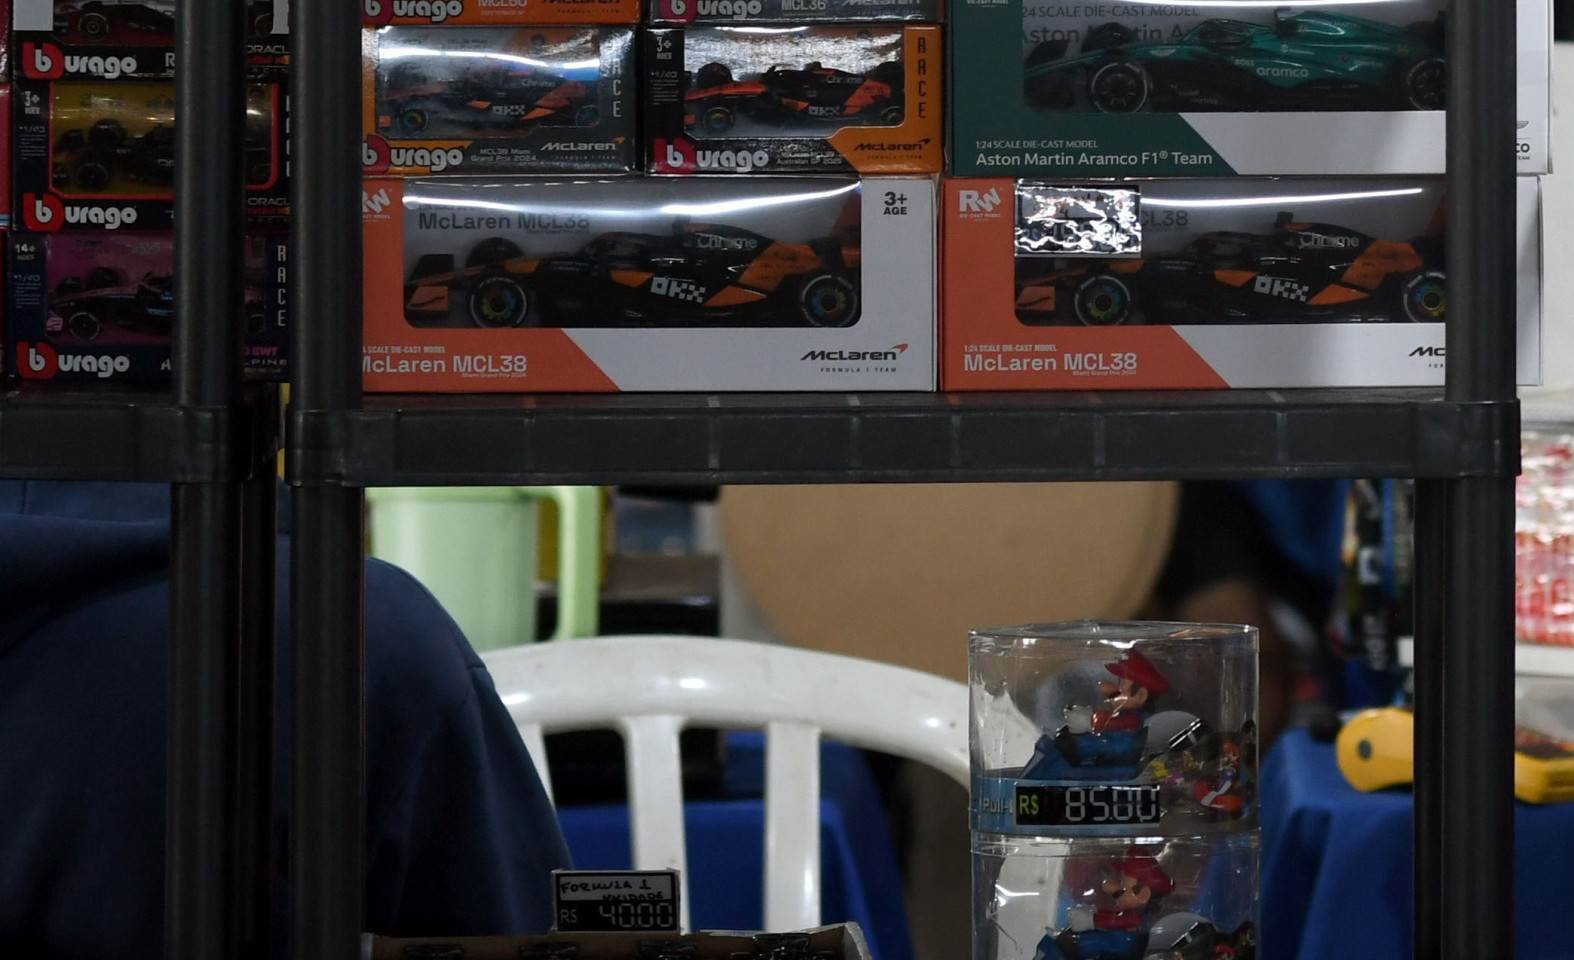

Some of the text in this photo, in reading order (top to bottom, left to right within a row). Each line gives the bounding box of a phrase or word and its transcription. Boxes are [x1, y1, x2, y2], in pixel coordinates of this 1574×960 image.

[781, 0, 826, 10] MCL36
[1039, 6, 1081, 18] SCALE
[1084, 6, 1148, 18] DIE-CAST
[1150, 4, 1199, 17] MODEL
[1256, 66, 1309, 78] aramco
[540, 142, 616, 151] McLaren
[854, 143, 923, 151] McLaren
[993, 140, 1022, 149] SCALE
[1023, 140, 1064, 149] DIE-CAST
[1066, 140, 1099, 148] MODEL
[976, 153, 1021, 166] Aston
[1025, 153, 1074, 165] Martin
[1078, 153, 1138, 165] Aramco
[1172, 152, 1213, 165] Team
[884, 191, 907, 206] 3+
[883, 207, 907, 215] AGE
[418, 212, 590, 230] McLaren MCL38
[651, 276, 706, 303] OKX
[1253, 275, 1309, 302] OKX
[801, 350, 897, 361] McLaren
[964, 353, 1138, 372] McLaren MCL38
[452, 355, 528, 373] MCL38
